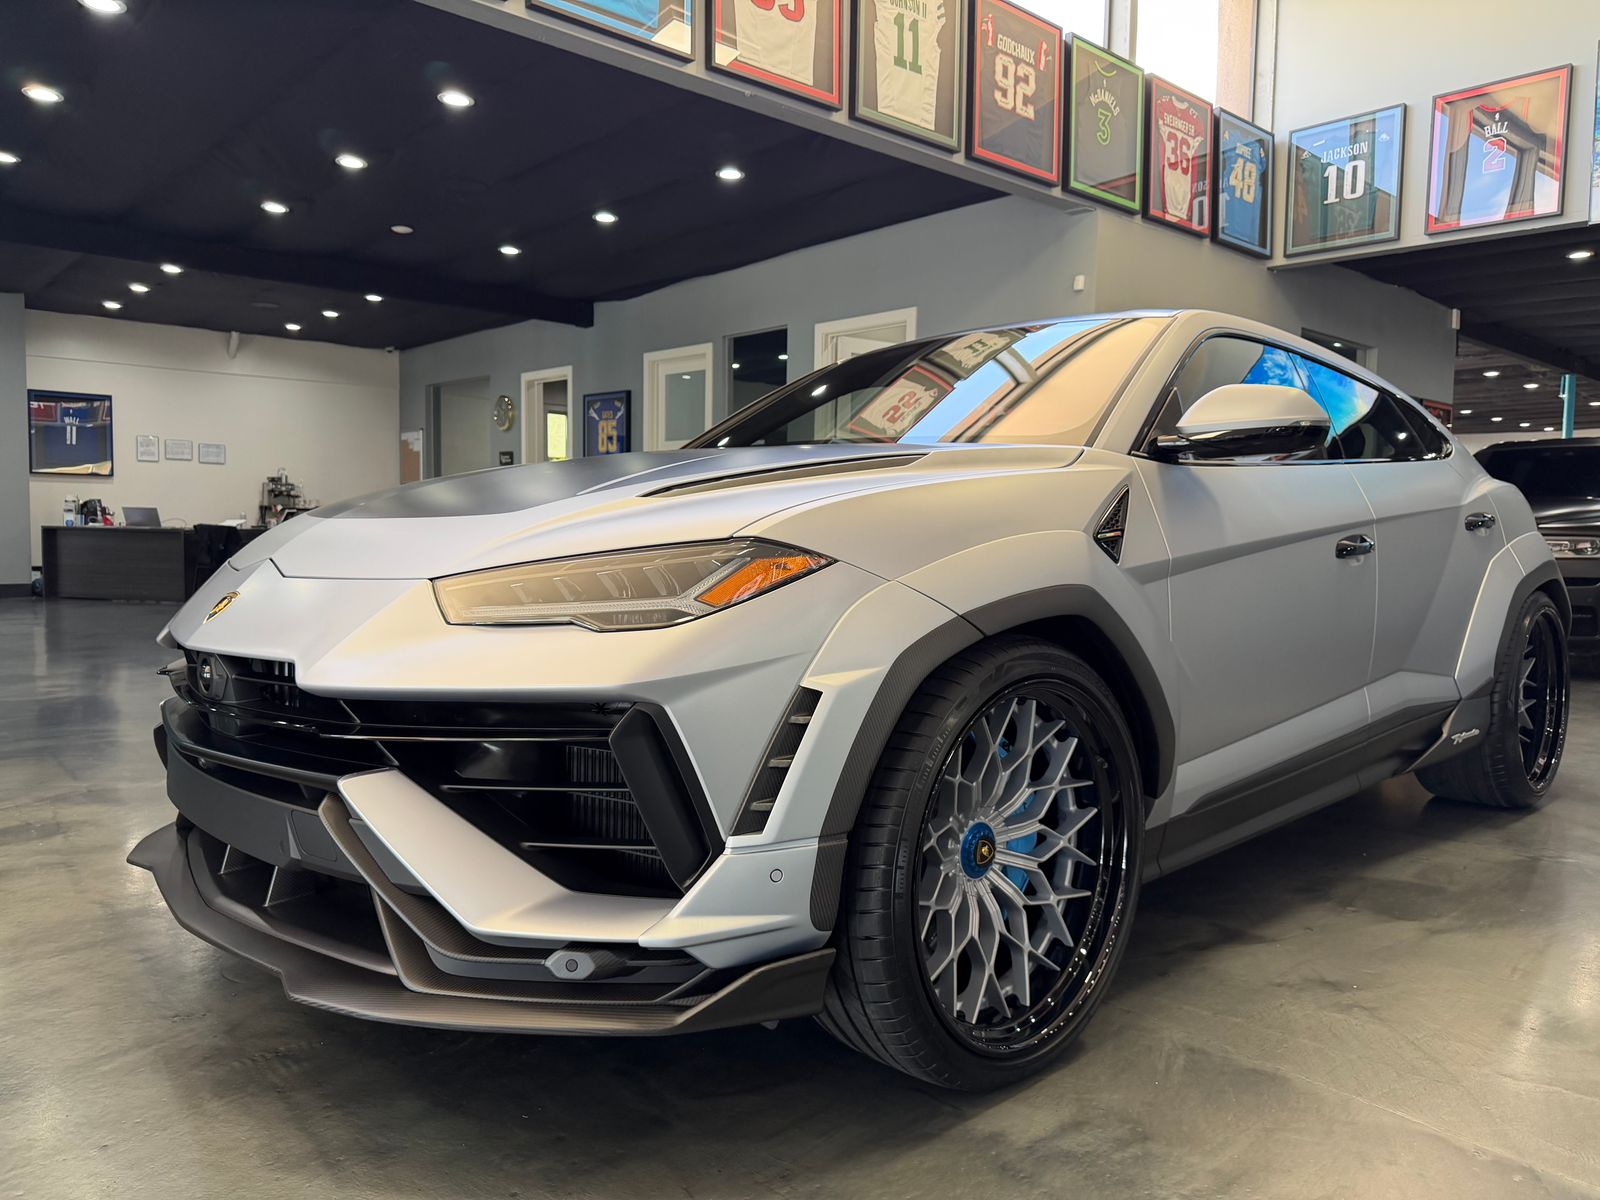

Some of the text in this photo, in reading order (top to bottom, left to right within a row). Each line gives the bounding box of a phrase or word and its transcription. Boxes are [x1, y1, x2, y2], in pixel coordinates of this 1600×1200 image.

[893, 13, 922, 74] 11
[997, 33, 1035, 65] GODCHAUX
[994, 53, 1035, 120] 92
[1097, 108, 1111, 145] 3
[1484, 122, 1508, 138] BALL
[1167, 131, 1191, 176] 36
[1320, 141, 1368, 163] JACKSON
[1482, 137, 1507, 174] 2
[1229, 157, 1256, 204] 48
[1322, 159, 1366, 205] 10
[64, 416, 80, 425] WALL
[66, 425, 77, 445] 11
[597, 420, 618, 453] 85
